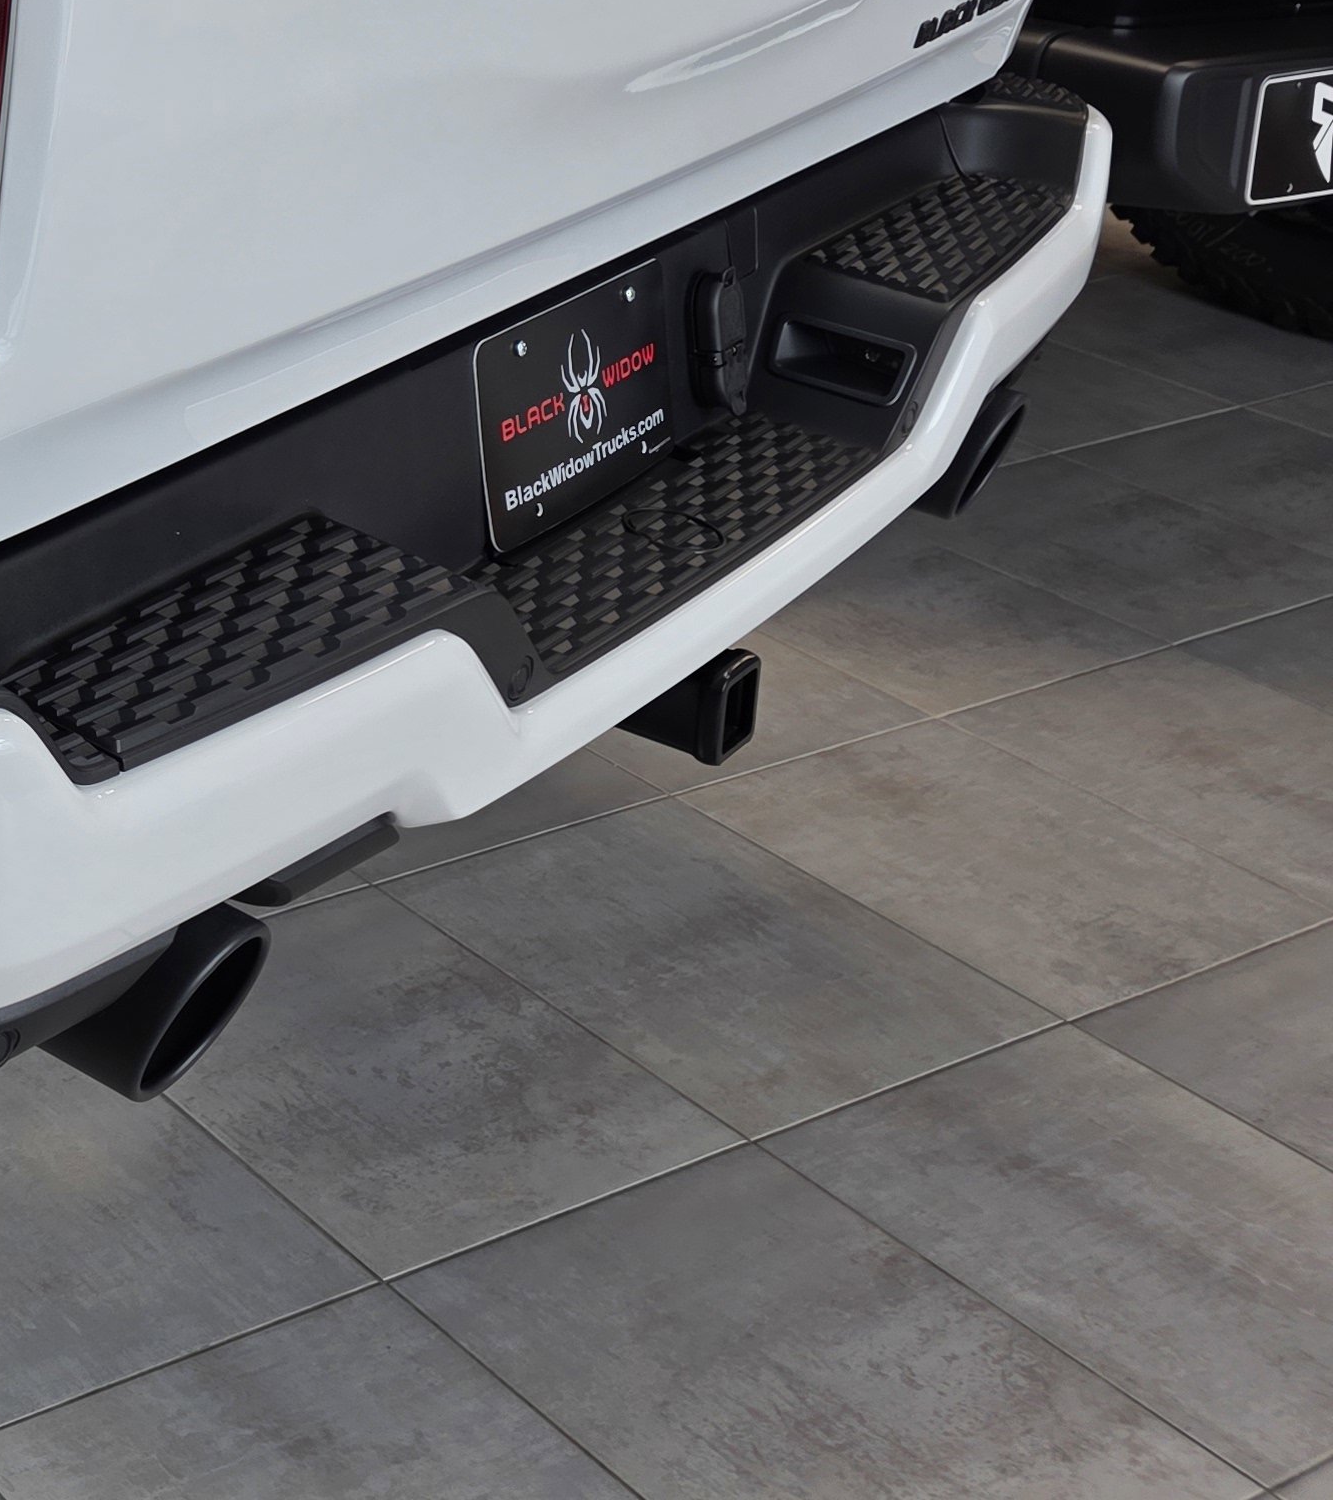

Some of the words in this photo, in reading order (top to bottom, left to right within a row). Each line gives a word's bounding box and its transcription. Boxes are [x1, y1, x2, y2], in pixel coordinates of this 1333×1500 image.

[500, 392, 565, 443] BLACK
[601, 342, 656, 388] WIDOW
[505, 407, 665, 512] BlackWidowTrucks.com
